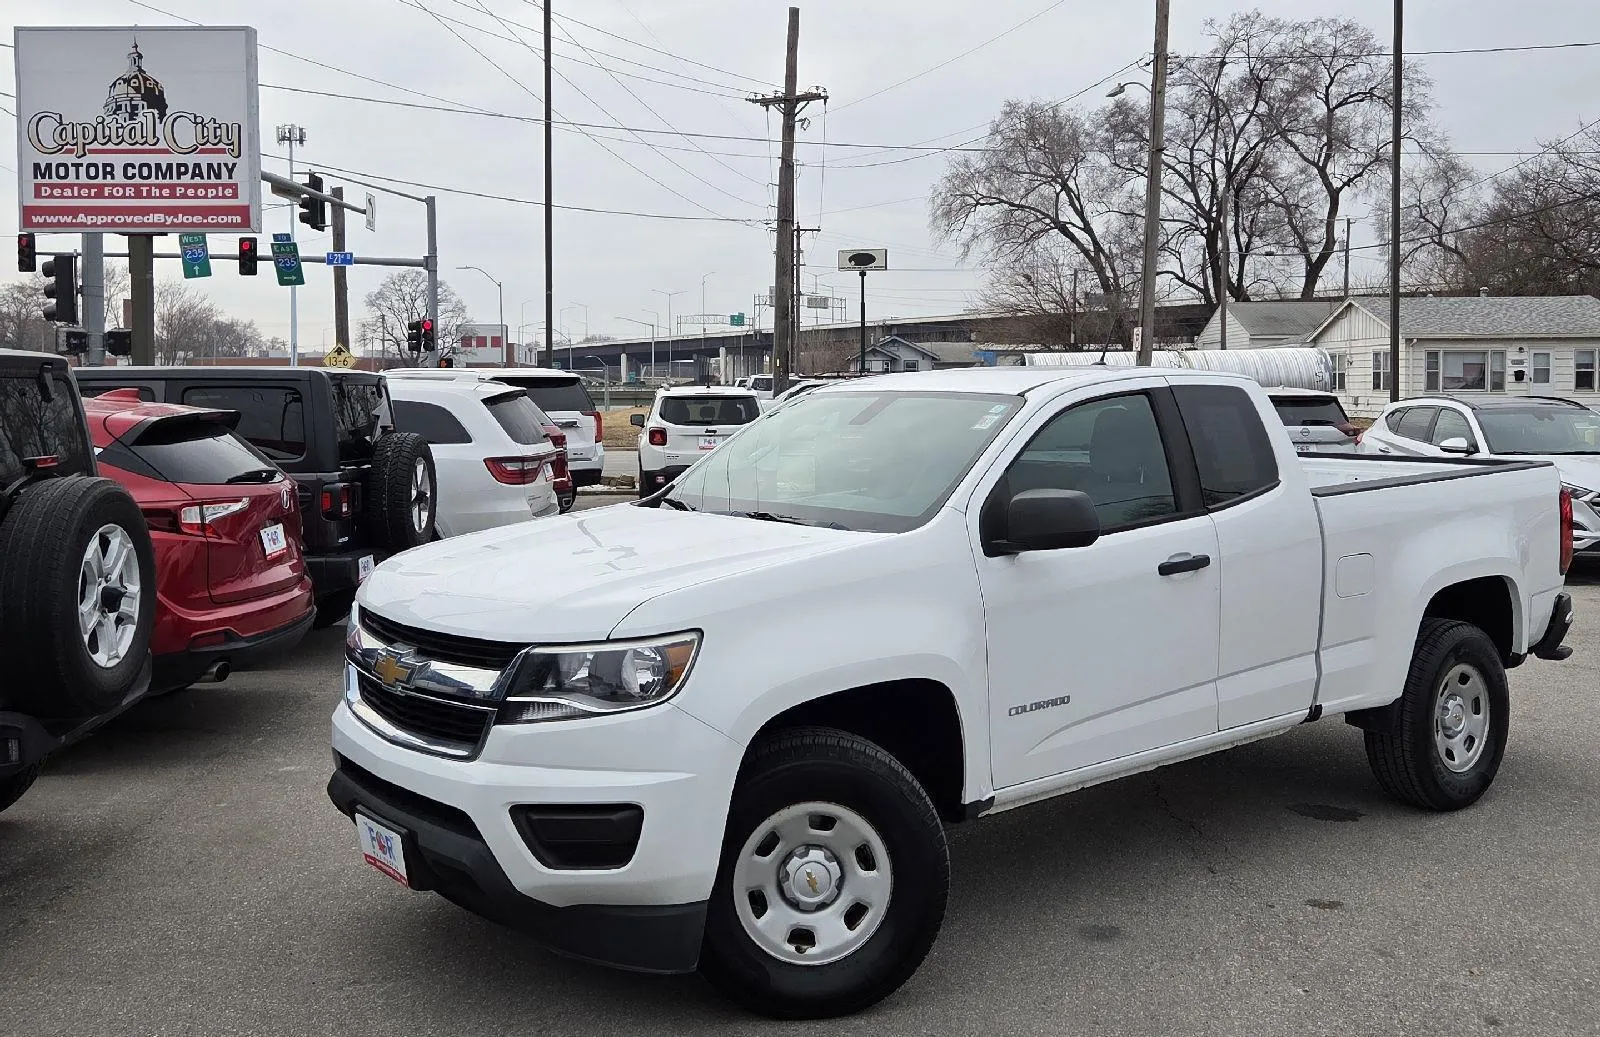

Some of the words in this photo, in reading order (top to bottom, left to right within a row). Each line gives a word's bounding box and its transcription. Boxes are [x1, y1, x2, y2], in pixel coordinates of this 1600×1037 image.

[28, 111, 159, 158] Capital
[163, 111, 241, 158] City
[33, 162, 116, 180] MOTOR
[122, 162, 238, 180] COMPANY
[41, 186, 97, 197] Dealer
[104, 186, 135, 197] FOR
[141, 186, 170, 197] The
[176, 186, 233, 199] People
[32, 213, 242, 225] www.ApprovedByJoe.com
[182, 235, 203, 243] WEST
[186, 249, 204, 258] 235
[278, 257, 296, 266] 235
[1009, 695, 1070, 716] COLORADO
